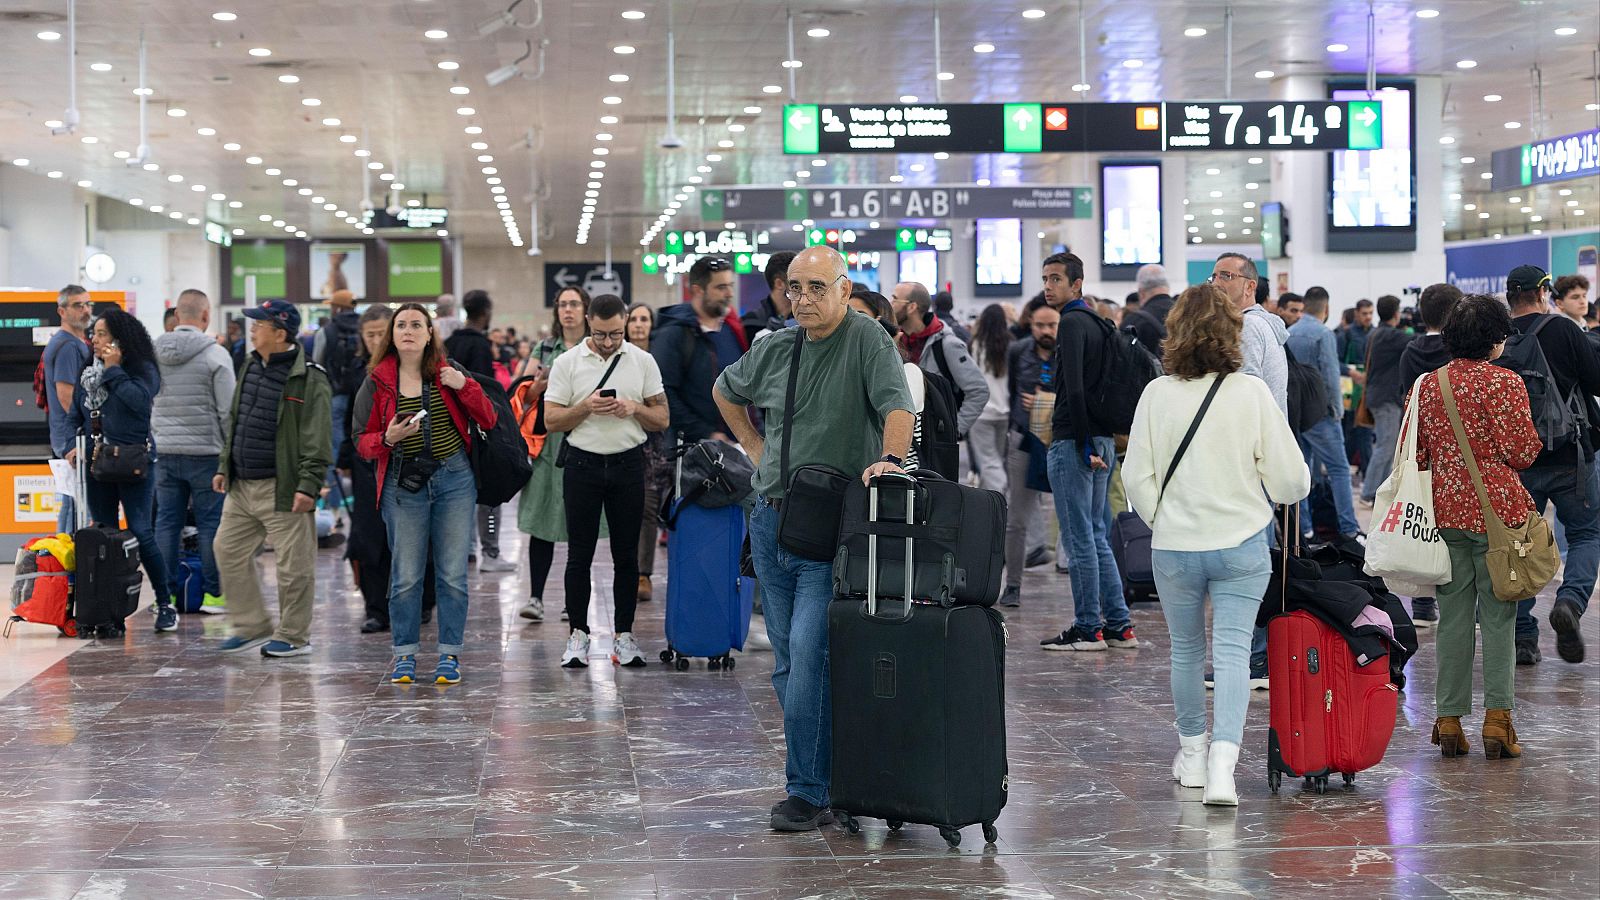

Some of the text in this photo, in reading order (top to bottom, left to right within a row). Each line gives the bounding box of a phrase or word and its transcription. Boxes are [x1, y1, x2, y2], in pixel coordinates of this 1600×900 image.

[1219, 105, 1319, 145] 7 a 14
[829, 190, 880, 217] 1 a 6
[717, 231, 732, 253] 6
